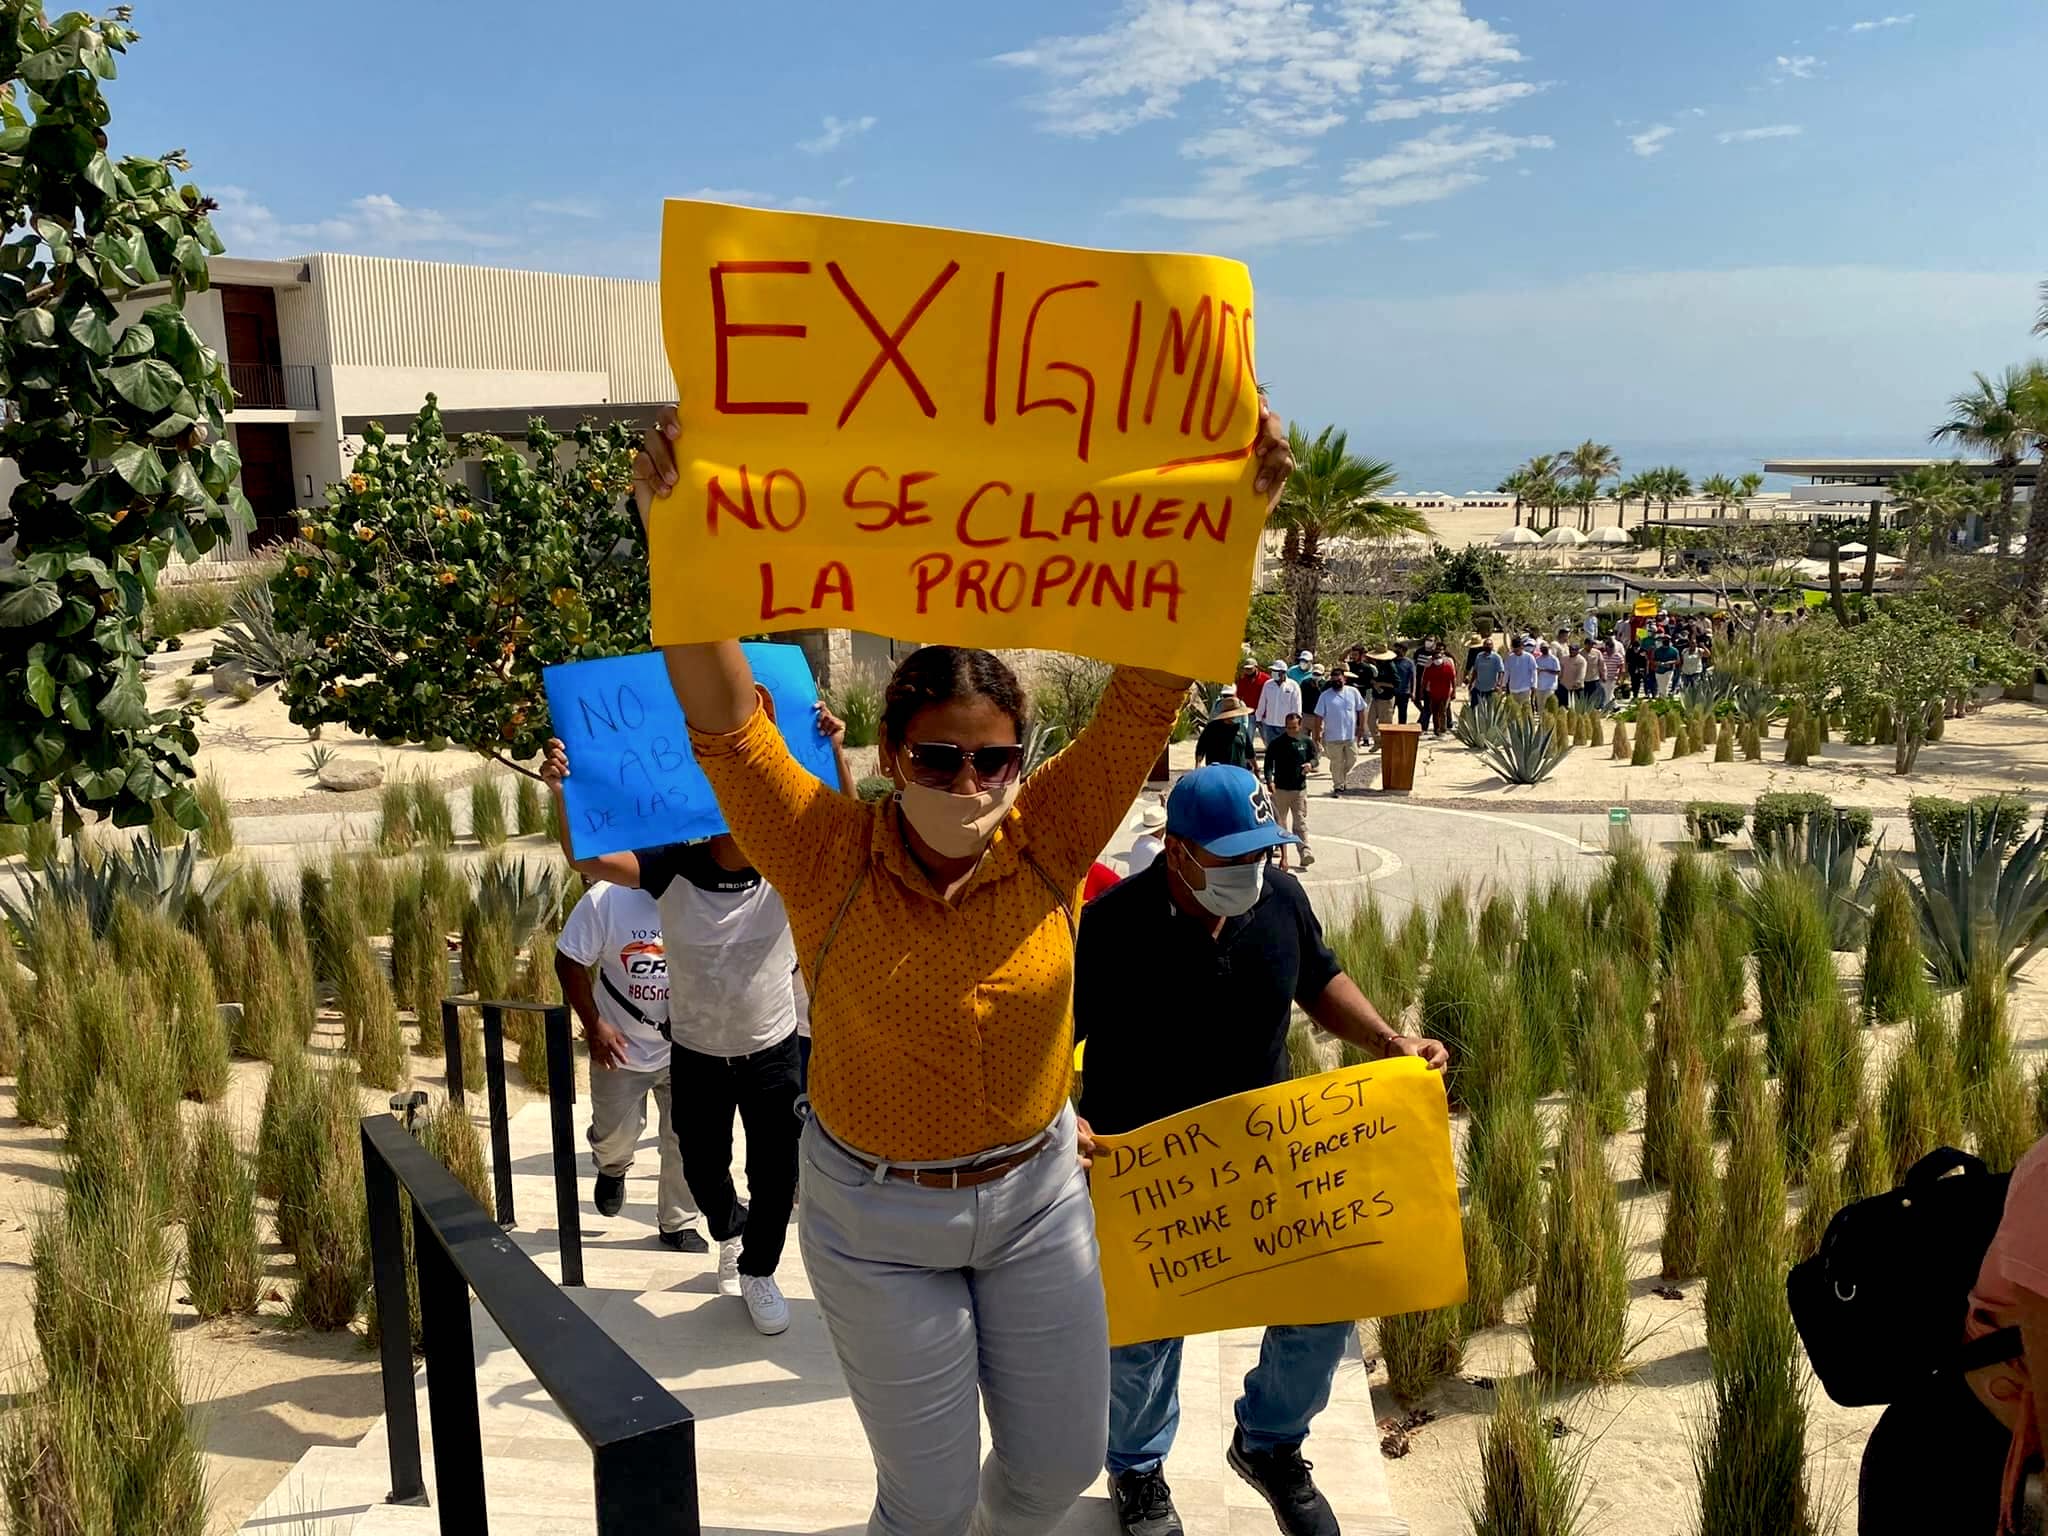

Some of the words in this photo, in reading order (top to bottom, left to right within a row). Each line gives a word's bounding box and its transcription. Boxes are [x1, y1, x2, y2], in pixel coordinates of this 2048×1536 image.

[706, 465, 808, 537] NO
[843, 466, 940, 532] SE
[956, 481, 1232, 548] CLAVEN
[760, 560, 855, 621] LA
[908, 552, 1185, 623] PROPINA
[578, 684, 645, 740] NO
[584, 808, 617, 833] DE
[635, 786, 689, 818] LAS
[631, 929, 647, 939] YO
[1109, 1122, 1221, 1178] DEAR
[1245, 1077, 1373, 1141] GUEST
[1120, 1175, 1194, 1216] THIS
[1210, 1160, 1240, 1188] IS
[1253, 1154, 1273, 1176] A
[1287, 1116, 1397, 1171] PEACEFUL
[1132, 1204, 1231, 1252] STRIKE
[1250, 1192, 1279, 1221] OF
[1296, 1169, 1348, 1199] THE
[1149, 1246, 1232, 1288] HOTEL
[1253, 1190, 1395, 1256] WORKERS
